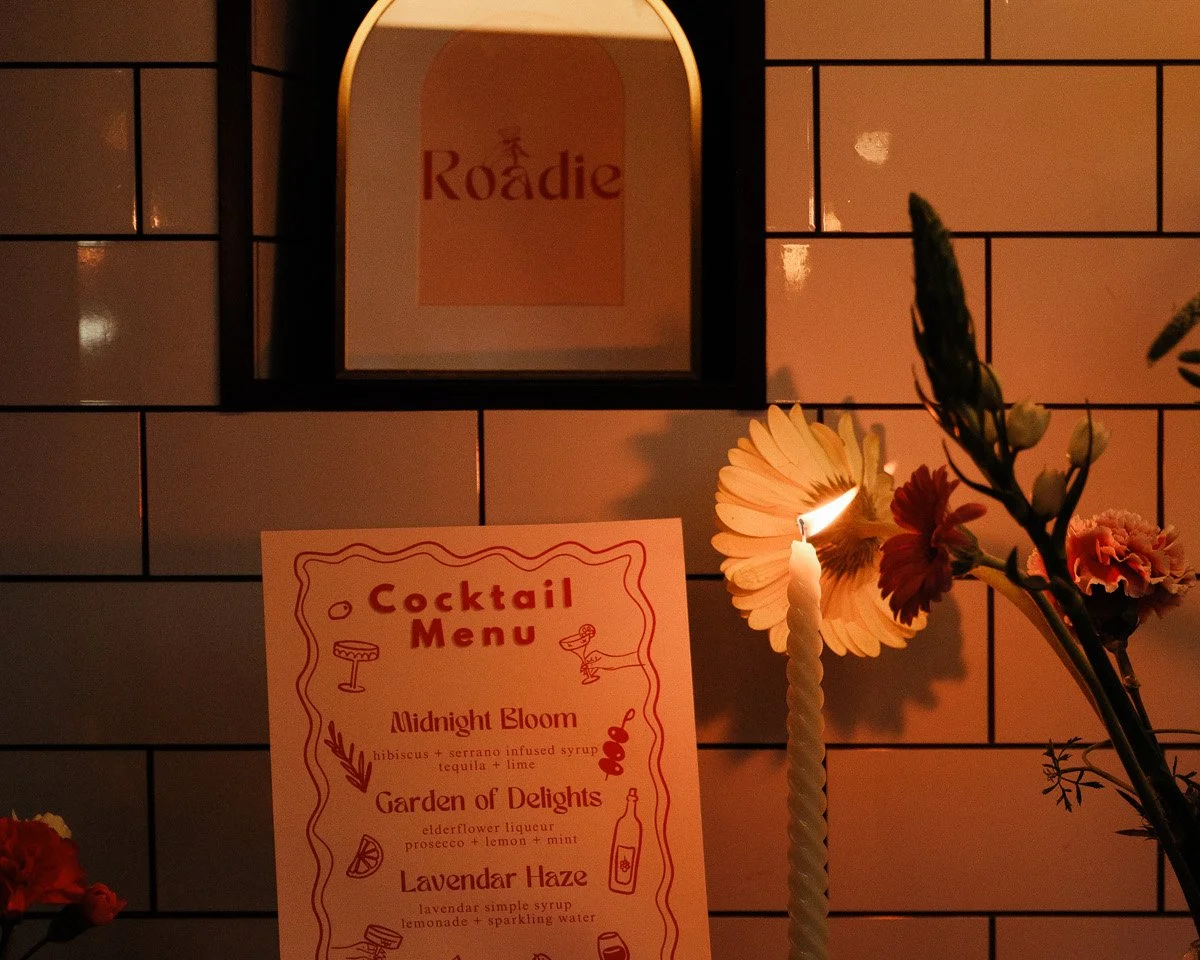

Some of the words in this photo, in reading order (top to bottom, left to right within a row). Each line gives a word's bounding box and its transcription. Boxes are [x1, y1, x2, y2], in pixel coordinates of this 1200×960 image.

[423, 149, 623, 201] Roadie
[369, 577, 573, 614] Cocktail
[411, 618, 535, 649] Menu
[390, 709, 492, 737] Midnight
[500, 708, 577, 730] Bloom
[373, 750, 429, 761] hibiscus
[449, 748, 500, 758] serrano
[506, 745, 555, 756] infused
[560, 746, 598, 757] syrup
[438, 760, 486, 773] tequila
[507, 759, 535, 770] lime
[375, 789, 465, 814] Garden
[474, 787, 499, 810] of
[508, 786, 602, 814] Delights
[422, 823, 500, 835] elderflower
[505, 822, 555, 834] liqueur
[405, 839, 465, 852] prosecco
[485, 836, 526, 847] lemon
[547, 834, 578, 845] mint
[400, 867, 517, 893] Lavendar
[526, 865, 588, 888] Haze
[419, 903, 479, 915] lavendar
[484, 900, 529, 913] simple
[534, 901, 572, 912] syrup
[401, 916, 468, 929] lemonade
[488, 913, 553, 927] sparkling
[558, 913, 596, 924] water
